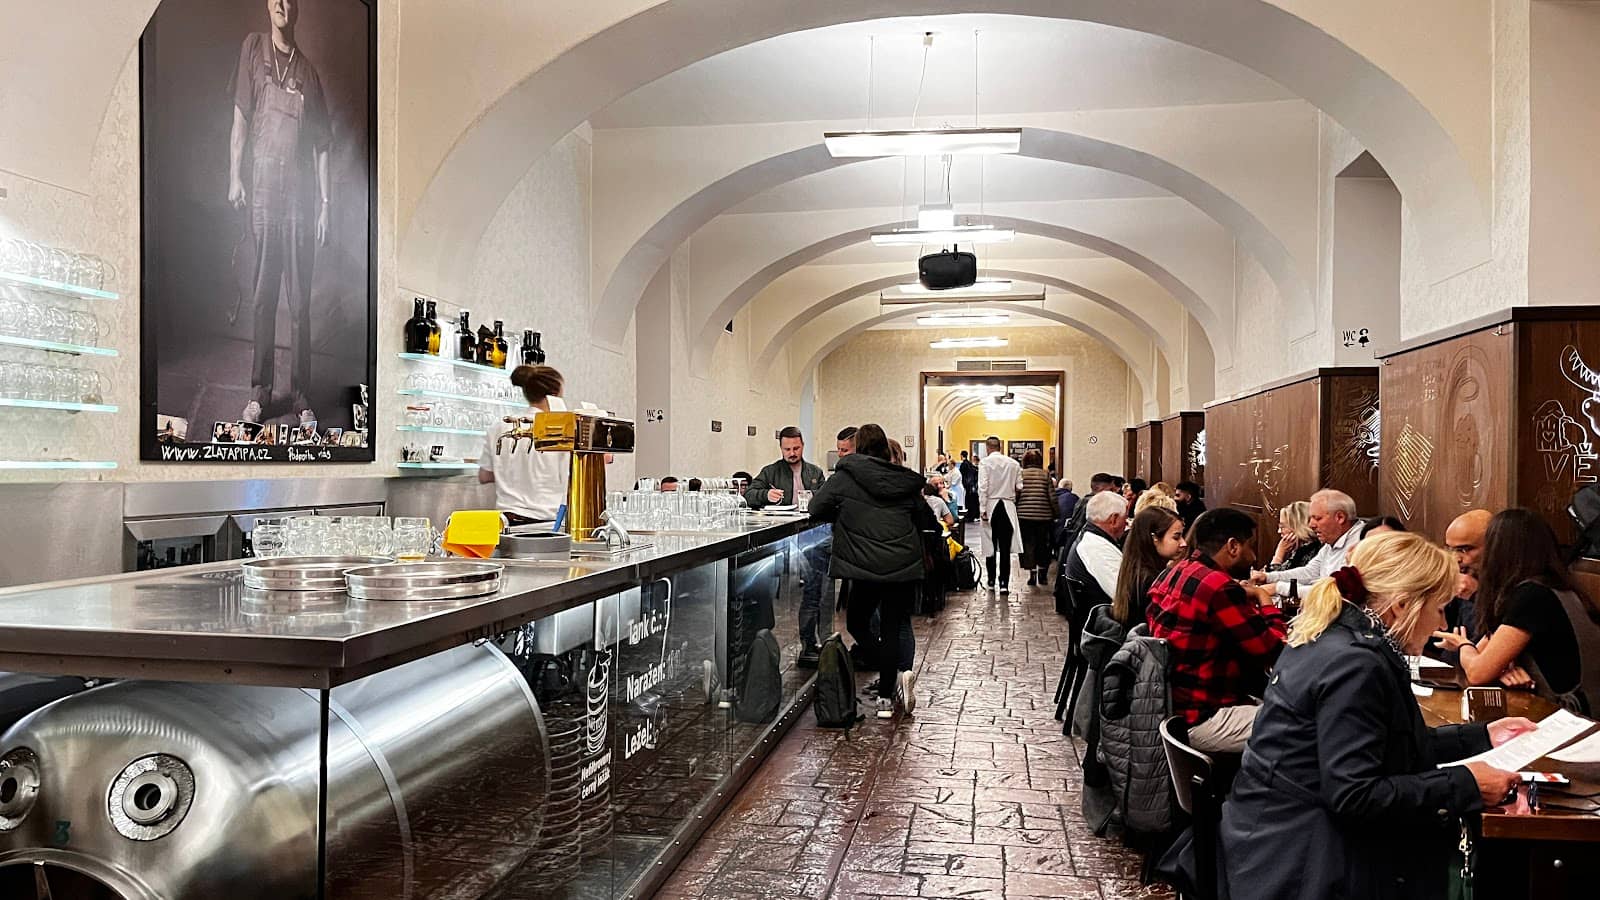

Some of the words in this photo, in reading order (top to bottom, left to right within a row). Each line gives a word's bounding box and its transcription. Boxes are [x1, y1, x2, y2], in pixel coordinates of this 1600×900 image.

[1343, 330, 1356, 341] WC
[628, 612, 649, 645] Tank
[626, 661, 666, 703] Naražen:
[625, 718, 652, 759] Ležel:
[581, 776, 597, 800] černý
